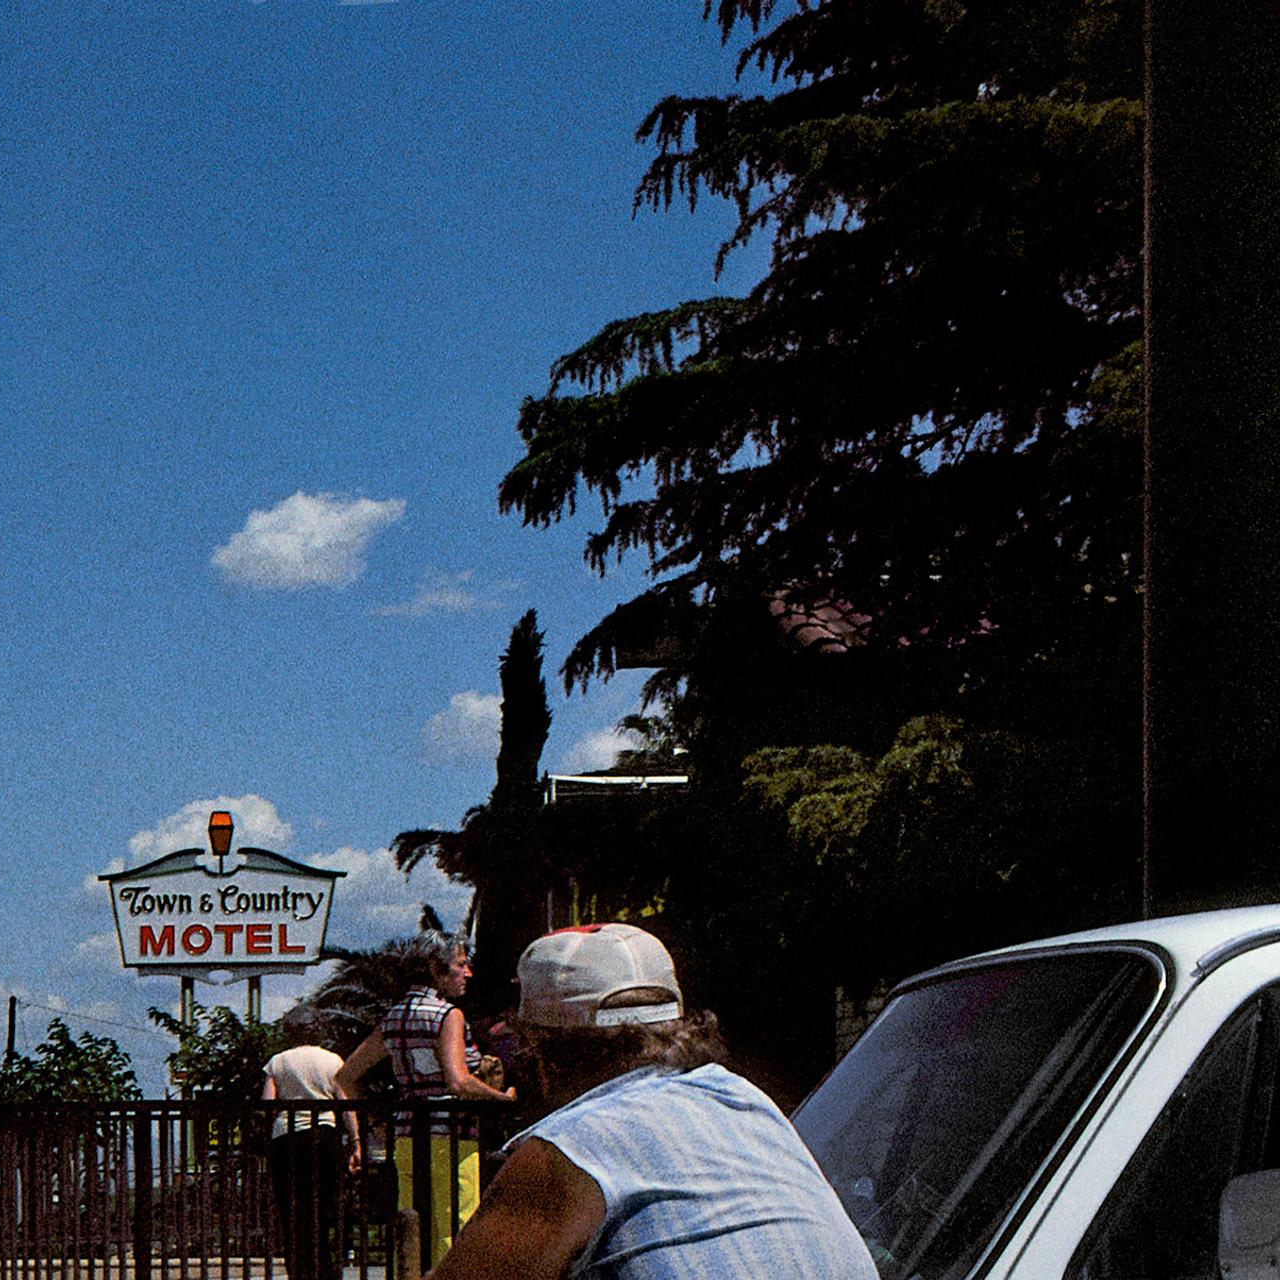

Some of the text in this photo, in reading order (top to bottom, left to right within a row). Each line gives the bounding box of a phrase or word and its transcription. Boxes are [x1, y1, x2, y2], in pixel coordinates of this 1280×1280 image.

[120, 884, 324, 920] Town & Country
[139, 923, 306, 957] MOTEL
